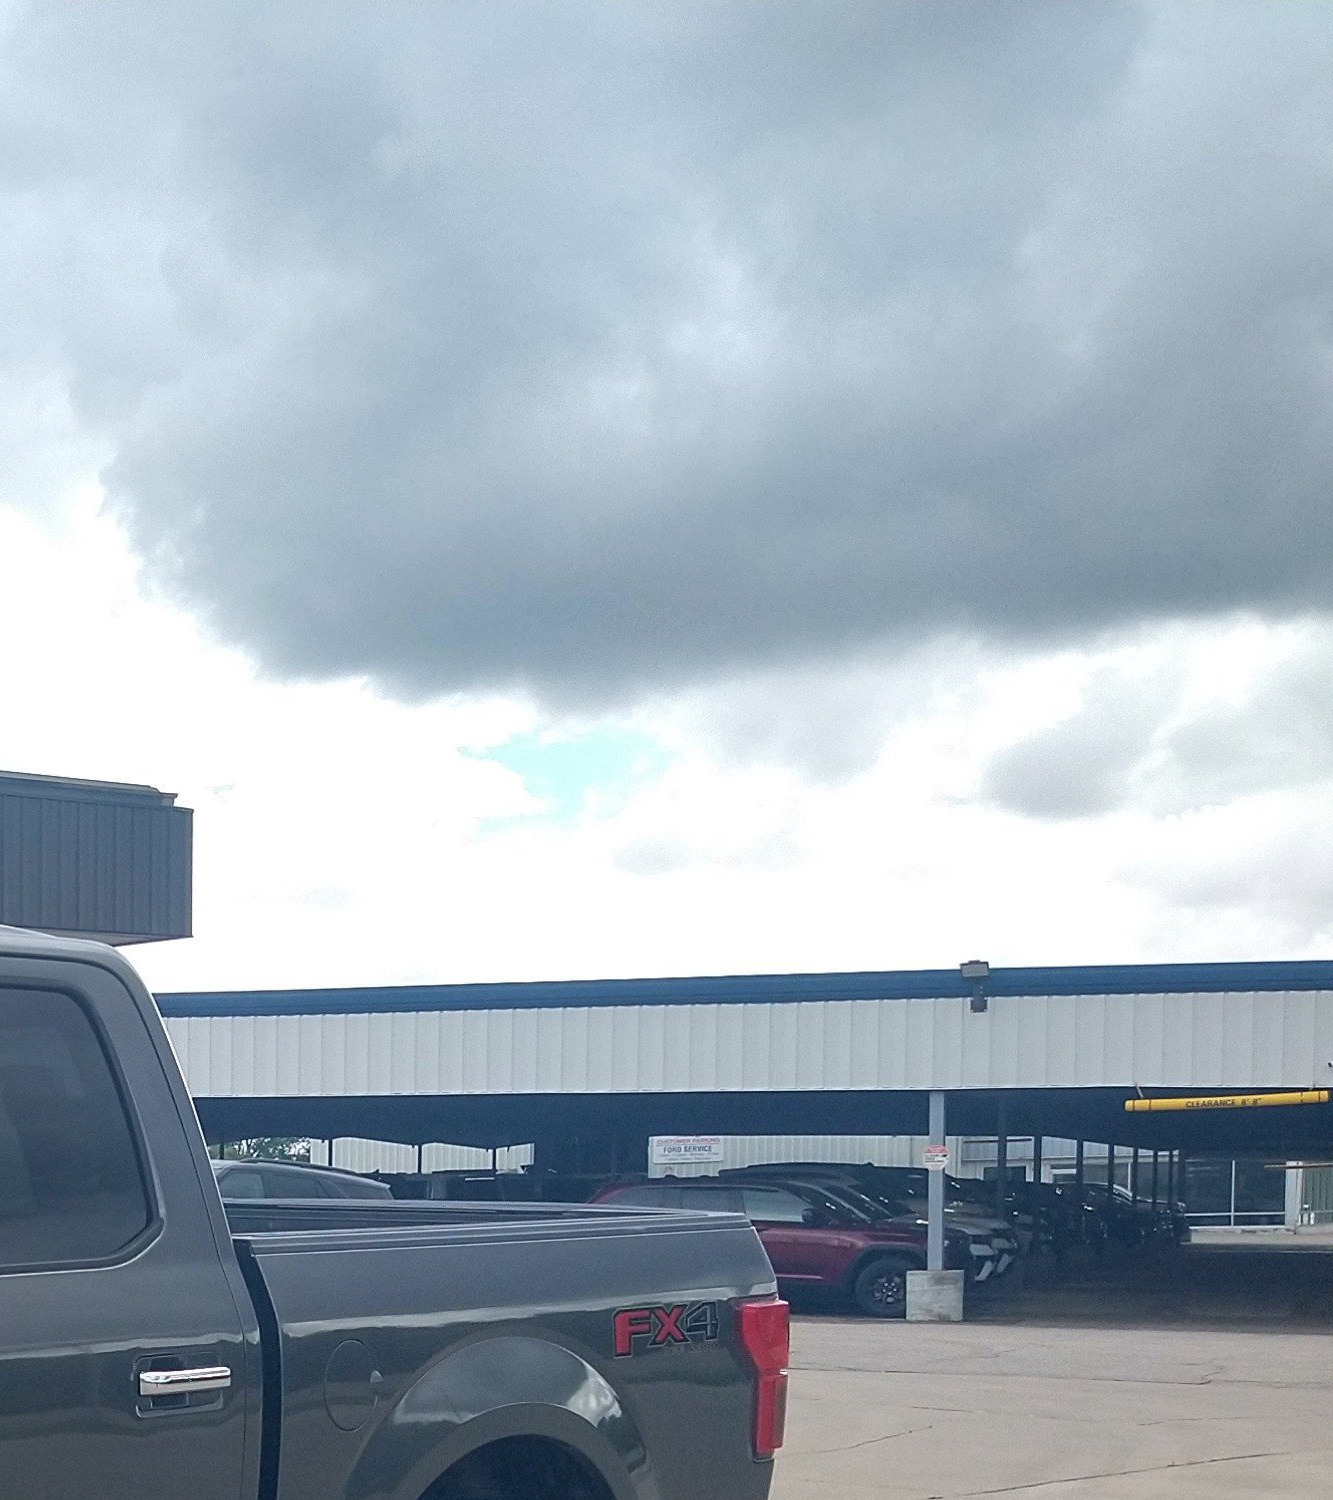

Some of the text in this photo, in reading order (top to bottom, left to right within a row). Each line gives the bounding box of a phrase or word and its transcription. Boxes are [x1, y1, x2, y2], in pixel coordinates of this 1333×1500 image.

[1185, 1098, 1237, 1108] CLEARANCE
[663, 1144, 713, 1154] FORD SERVICE
[612, 1300, 719, 1359] FX4
